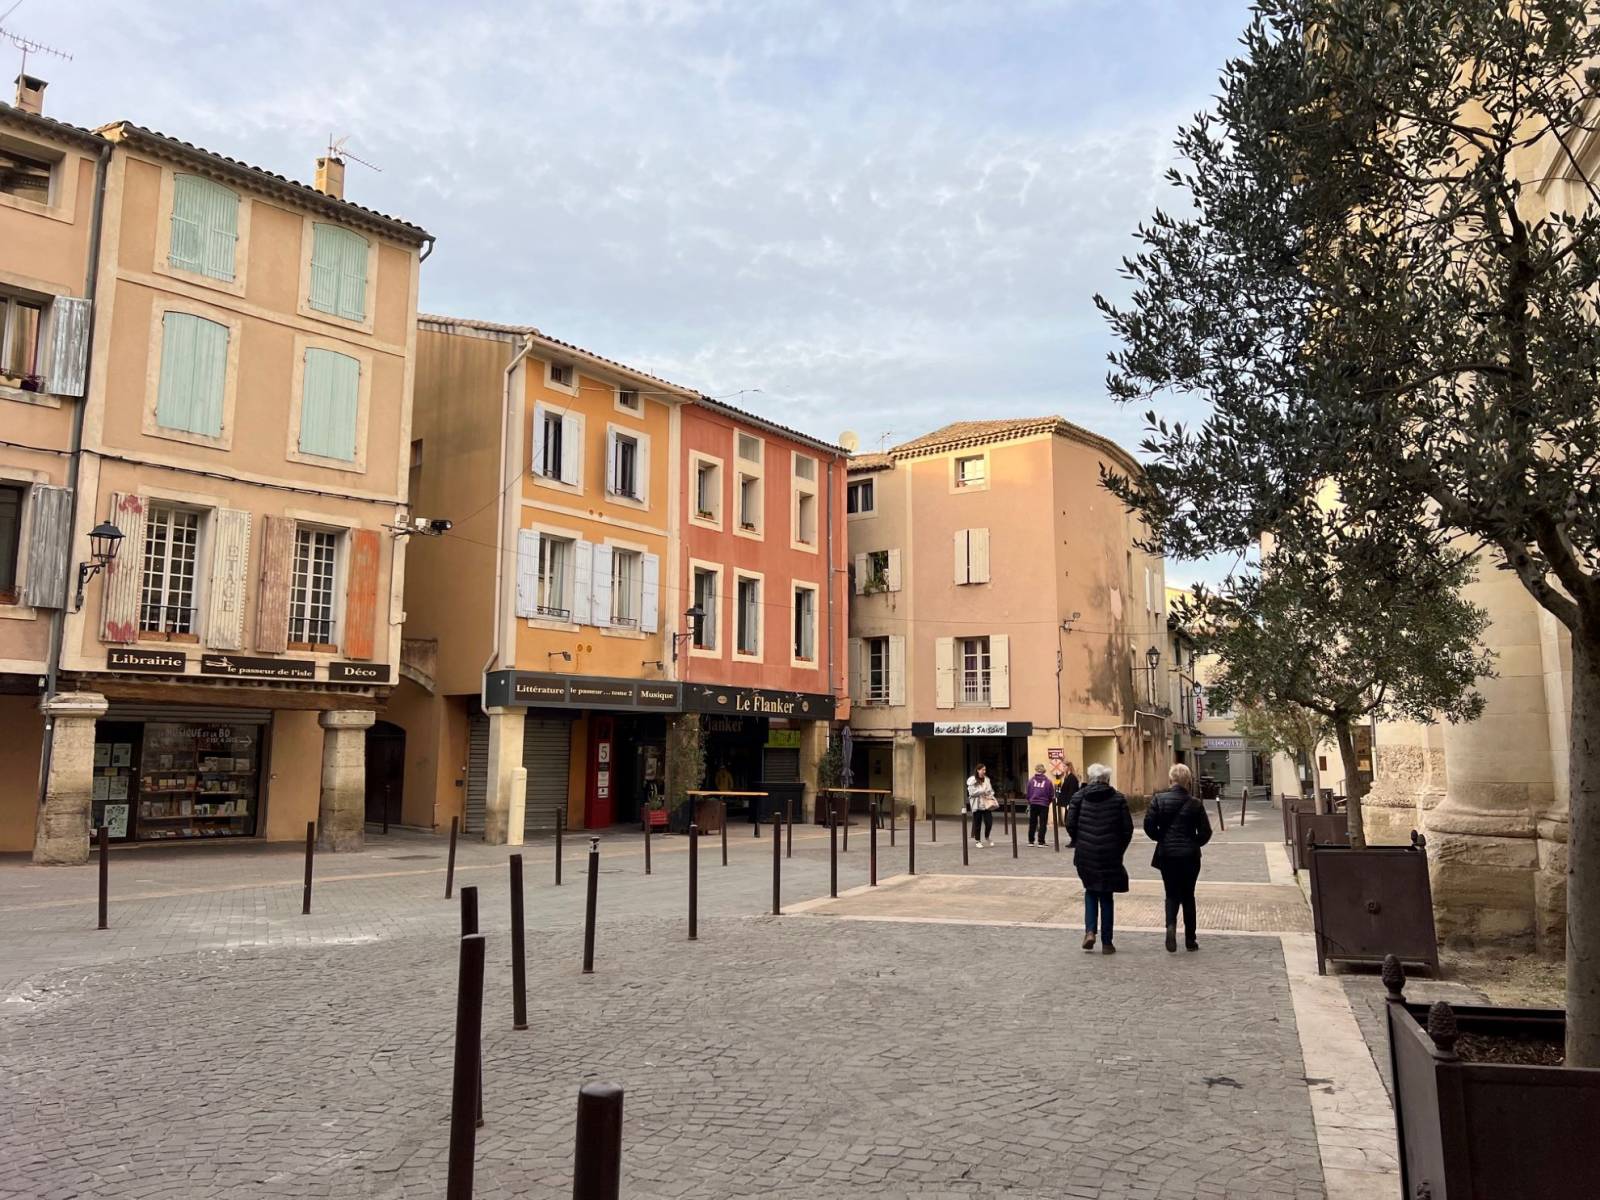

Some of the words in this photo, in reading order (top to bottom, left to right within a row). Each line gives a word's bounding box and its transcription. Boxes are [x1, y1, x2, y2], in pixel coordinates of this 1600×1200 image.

[111, 653, 182, 667] Librairie
[227, 665, 237, 673] le
[238, 667, 275, 675] passeur
[277, 668, 289, 676] de
[291, 669, 313, 677] l'isle
[344, 667, 377, 677] Déco
[516, 684, 565, 695] Littérature
[640, 690, 674, 701] Musique
[736, 694, 750, 712] Le
[753, 696, 795, 714] Flanker
[601, 745, 608, 760] 5
